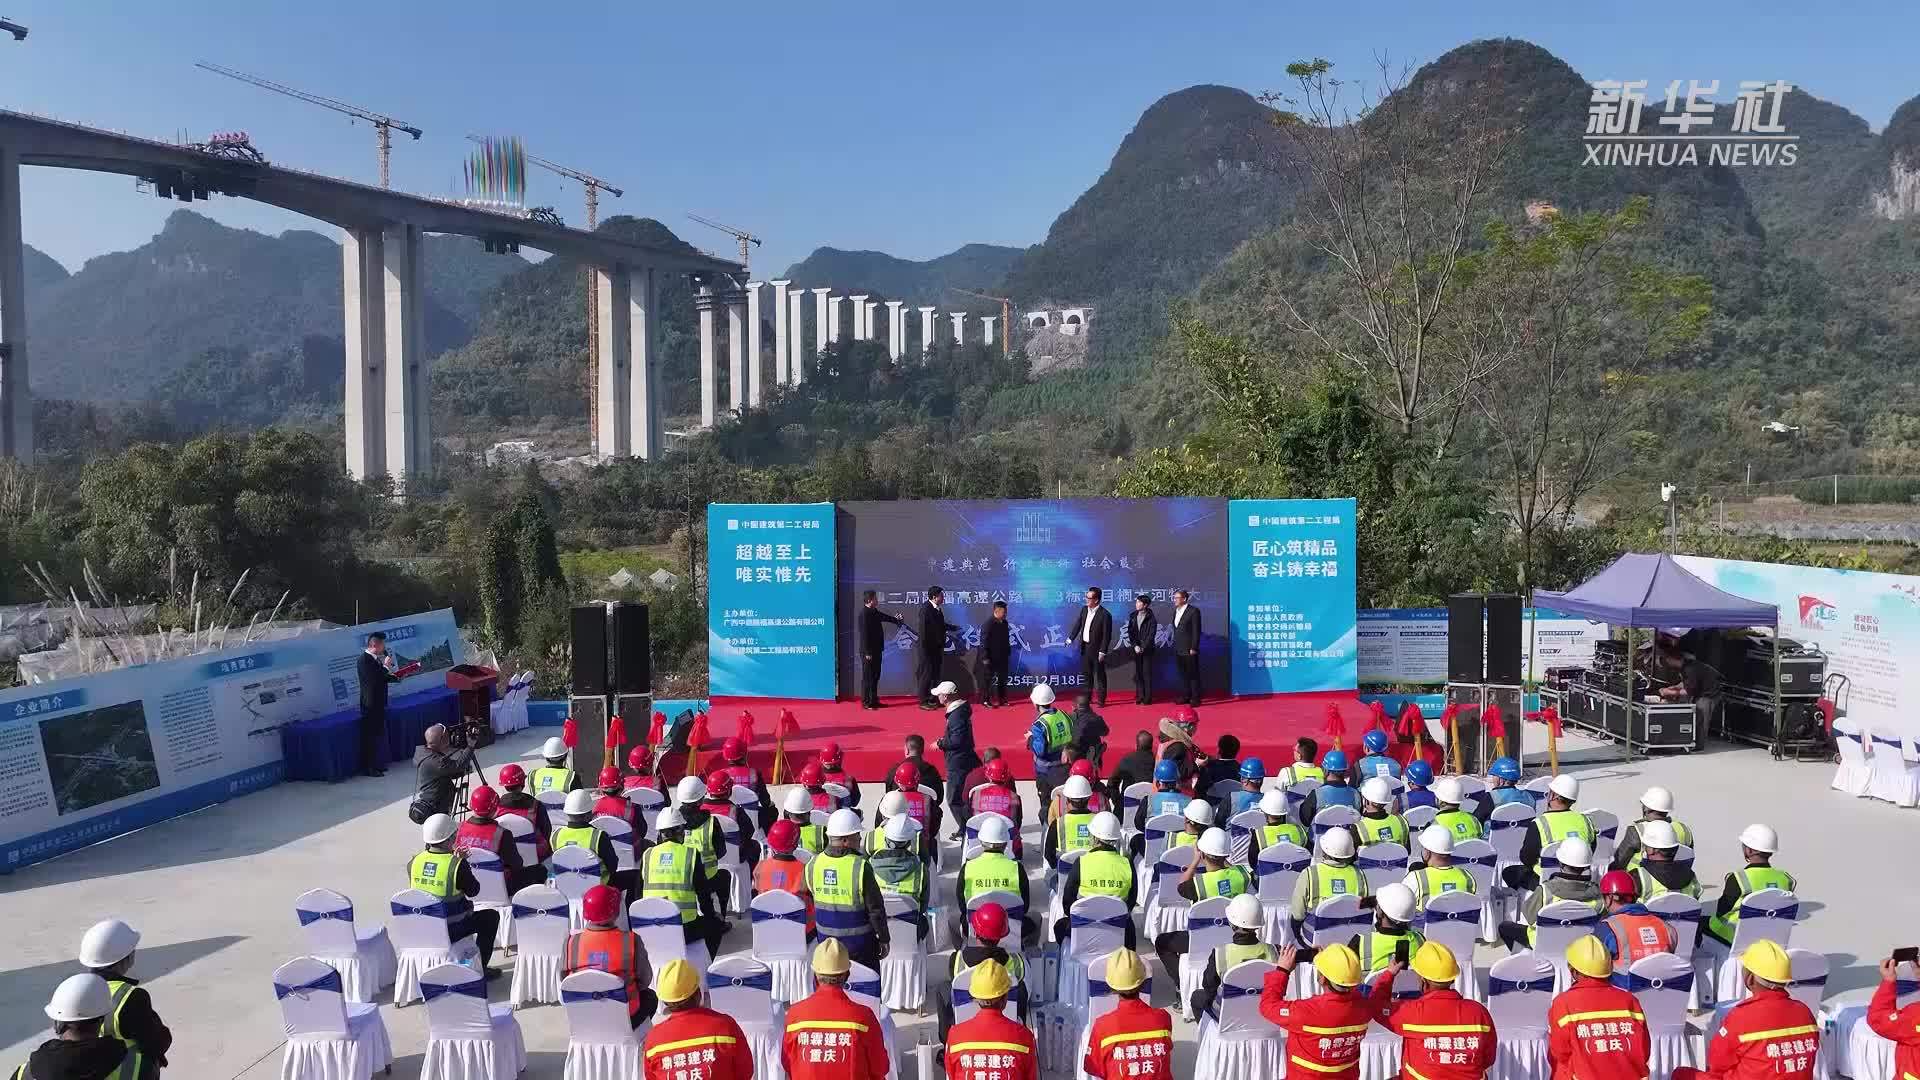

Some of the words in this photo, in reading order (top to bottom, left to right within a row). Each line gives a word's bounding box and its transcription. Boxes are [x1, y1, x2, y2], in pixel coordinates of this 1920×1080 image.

[735, 543, 812, 561] 超越至上
[1252, 540, 1338, 557] 匠心筑精品
[735, 566, 812, 583] 唯实惟先
[1252, 561, 1338, 578] 奋斗铸幸福
[992, 674, 1086, 687] 225年12月18日
[15, 696, 64, 717] 企业简介
[975, 878, 1010, 889] 项目管理
[1090, 878, 1124, 889] 项目管理
